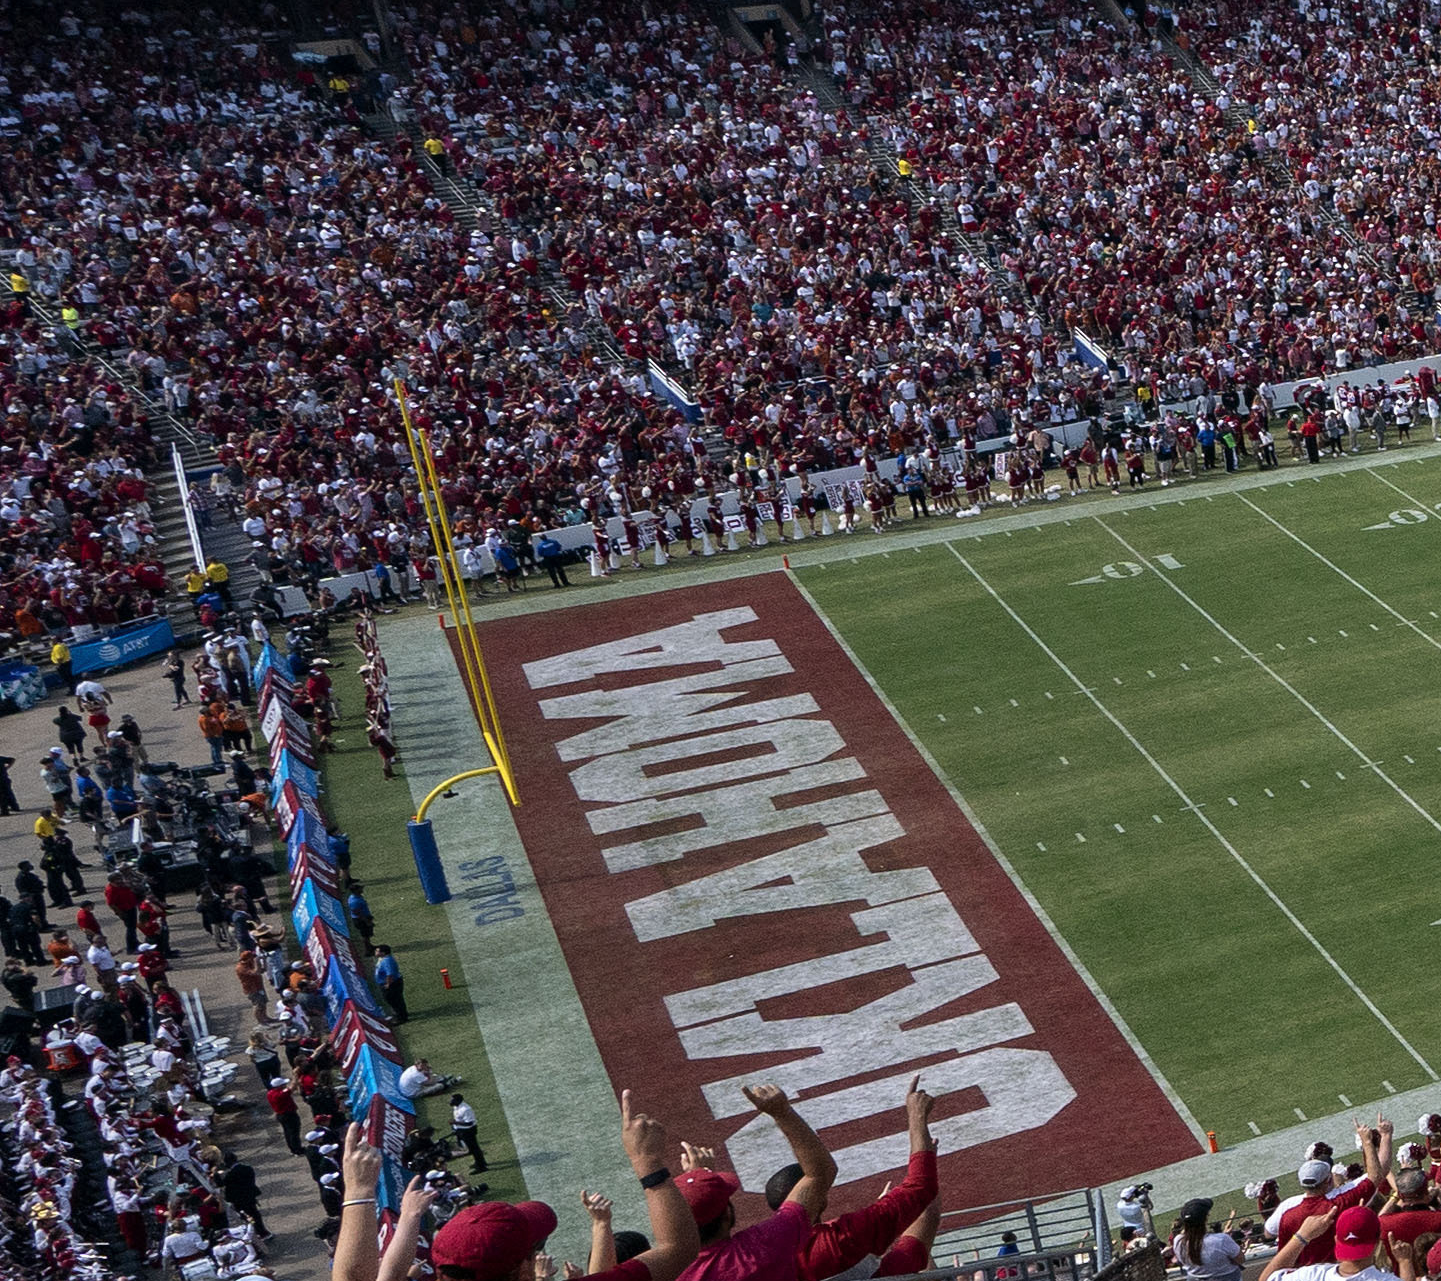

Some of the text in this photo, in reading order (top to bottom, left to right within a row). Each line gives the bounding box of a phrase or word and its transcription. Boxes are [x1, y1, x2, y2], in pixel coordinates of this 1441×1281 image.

[1102, 551, 1187, 580] 10
[123, 635, 150, 654] AT&T
[459, 855, 525, 926] DALLAS
[522, 606, 1078, 1194] OKLAHOMA
